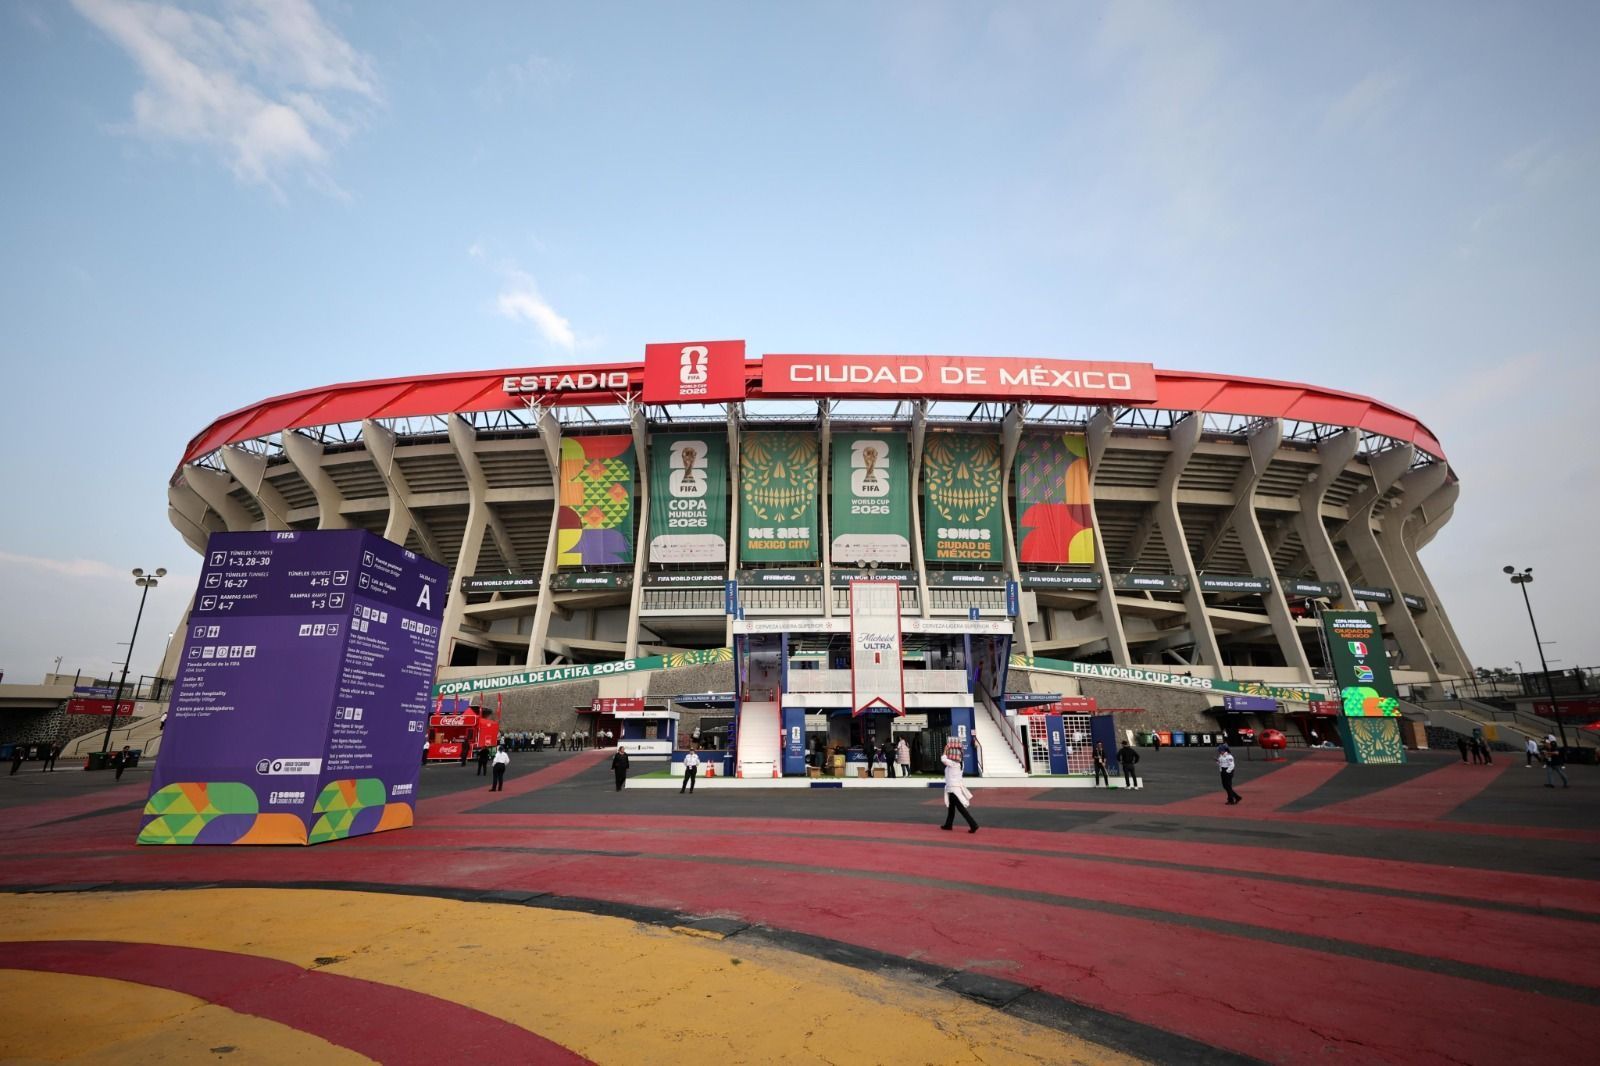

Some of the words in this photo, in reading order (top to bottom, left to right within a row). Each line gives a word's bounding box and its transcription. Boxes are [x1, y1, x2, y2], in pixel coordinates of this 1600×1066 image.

[503, 372, 628, 392] ESTADIO
[789, 364, 923, 384] CIUDAD
[940, 367, 986, 384] DE
[1000, 365, 1132, 390] MÉXICO
[669, 499, 707, 510] COPA
[851, 506, 890, 514] 2026
[668, 519, 707, 527] 2026
[748, 528, 774, 538] WE
[937, 528, 990, 540] SOMOS
[748, 540, 785, 549] MEXICO
[788, 540, 809, 549] CITY
[937, 541, 977, 550] CIUDAD
[979, 542, 990, 550] DE
[404, 550, 416, 559] FIFA
[937, 549, 991, 558] MÉXICO
[416, 584, 431, 610] A
[858, 632, 895, 642] Michelob
[440, 684, 471, 694] COPA
[473, 674, 526, 690] MUNDIAL
[529, 671, 544, 682] DE
[546, 670, 562, 680] LA
[564, 667, 590, 677] FIFA
[593, 660, 636, 675] 2026
[1073, 663, 1099, 674] FIFA
[1100, 666, 1143, 680] WORLD
[1145, 672, 1170, 682] CUP
[1171, 675, 1212, 688] 2026
[440, 716, 464, 725] Coca-Cola
